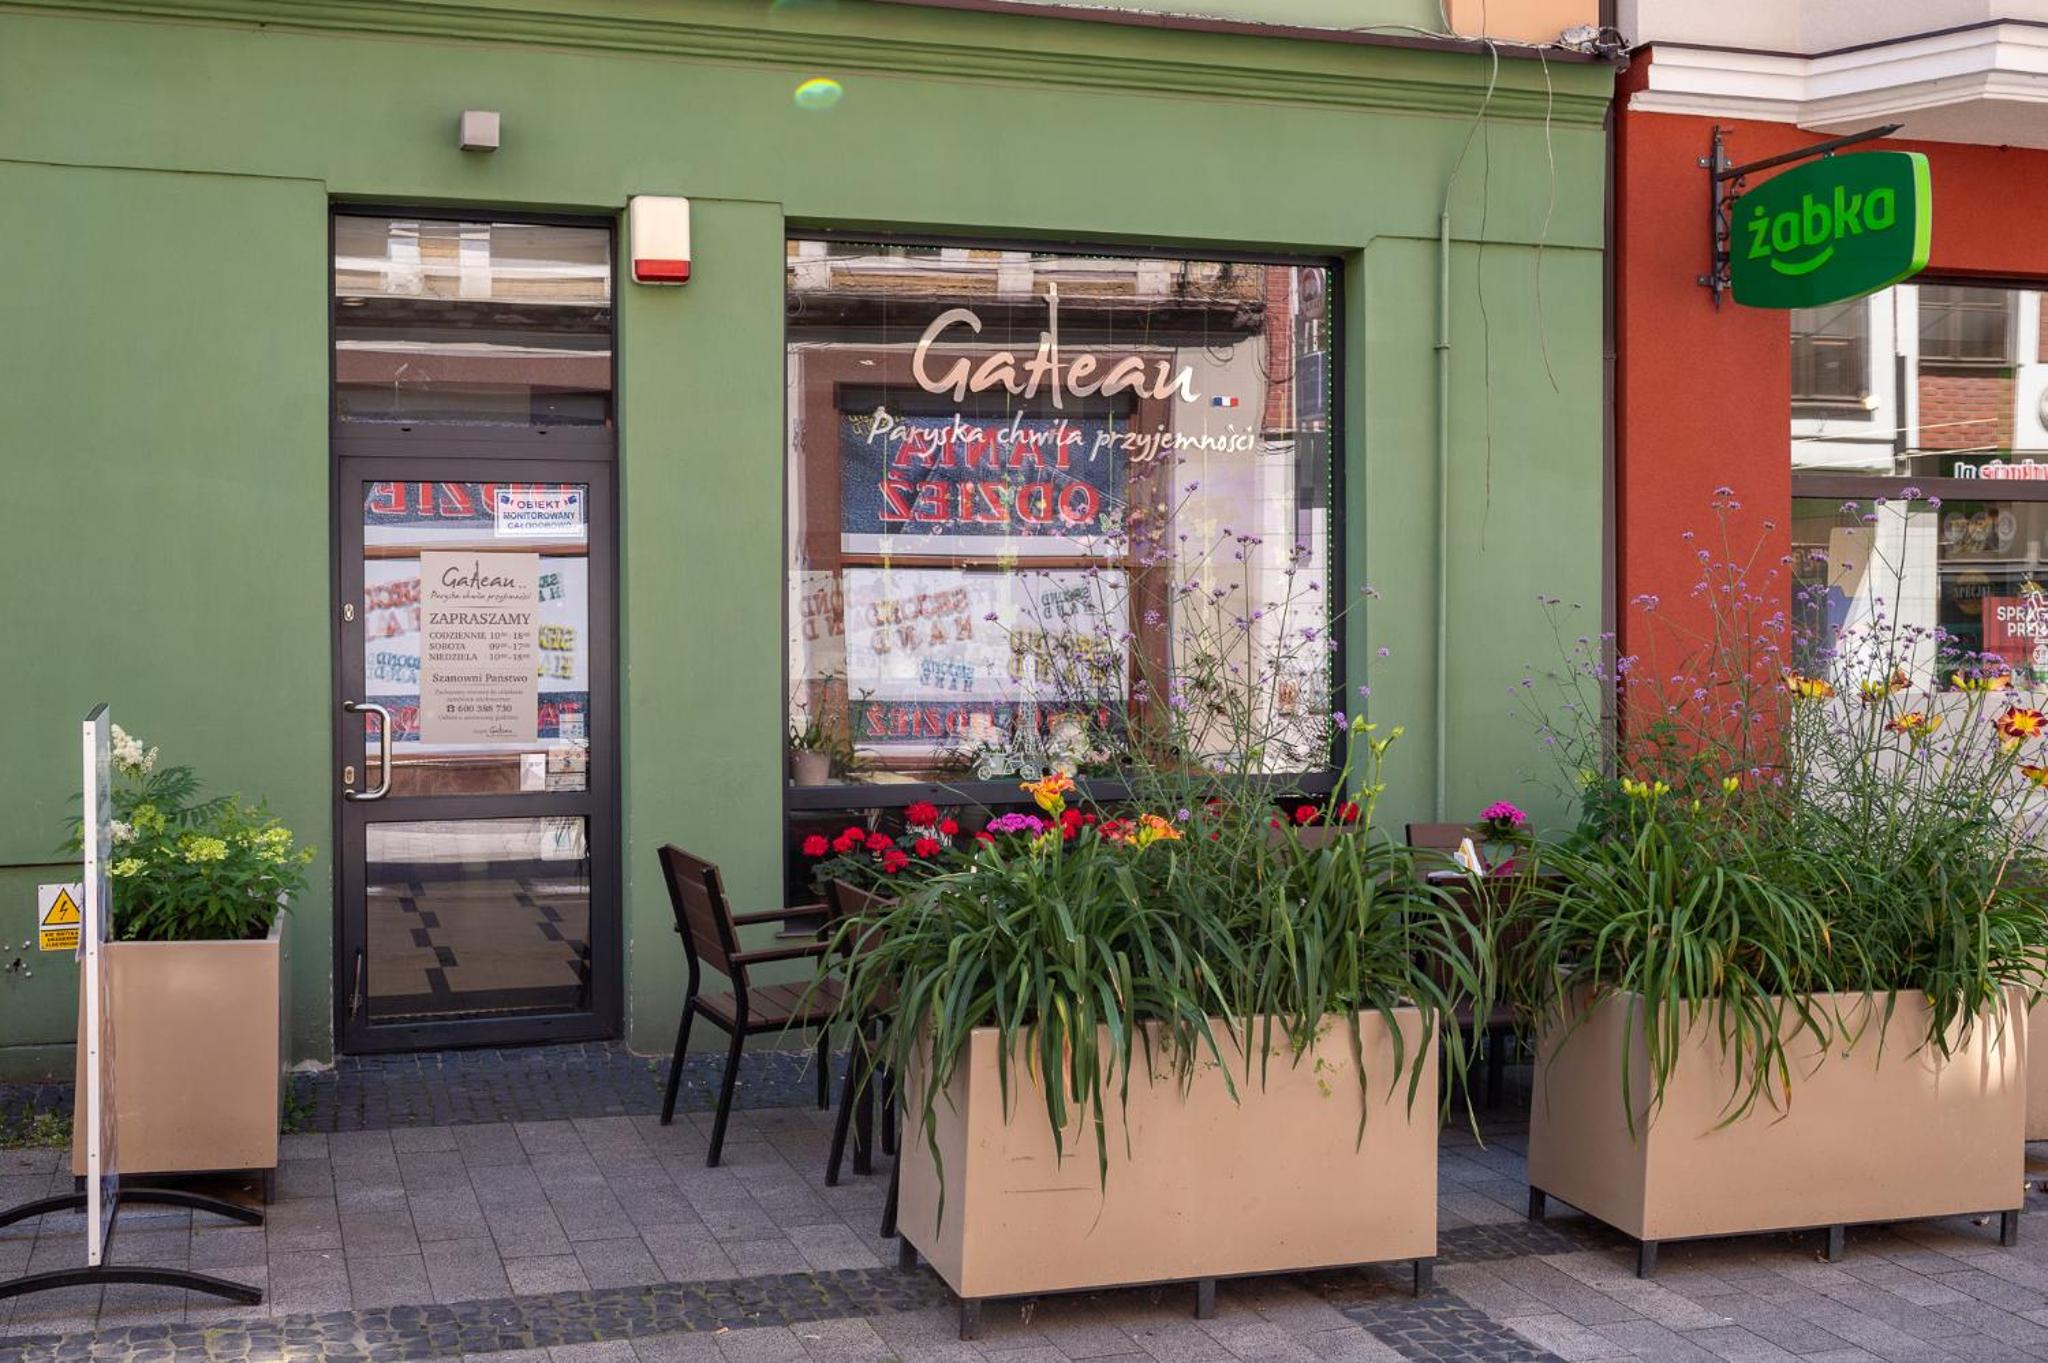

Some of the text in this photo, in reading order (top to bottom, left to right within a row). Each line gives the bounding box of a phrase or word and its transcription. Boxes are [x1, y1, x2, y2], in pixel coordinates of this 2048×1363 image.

[1748, 185, 1895, 259] żabka
[912, 282, 1201, 409] Gateau
[866, 407, 987, 457] Paryska
[997, 410, 1084, 449] chwila
[1089, 422, 1255, 461] przyjemności
[429, 612, 531, 625] ZAPRASZAMY
